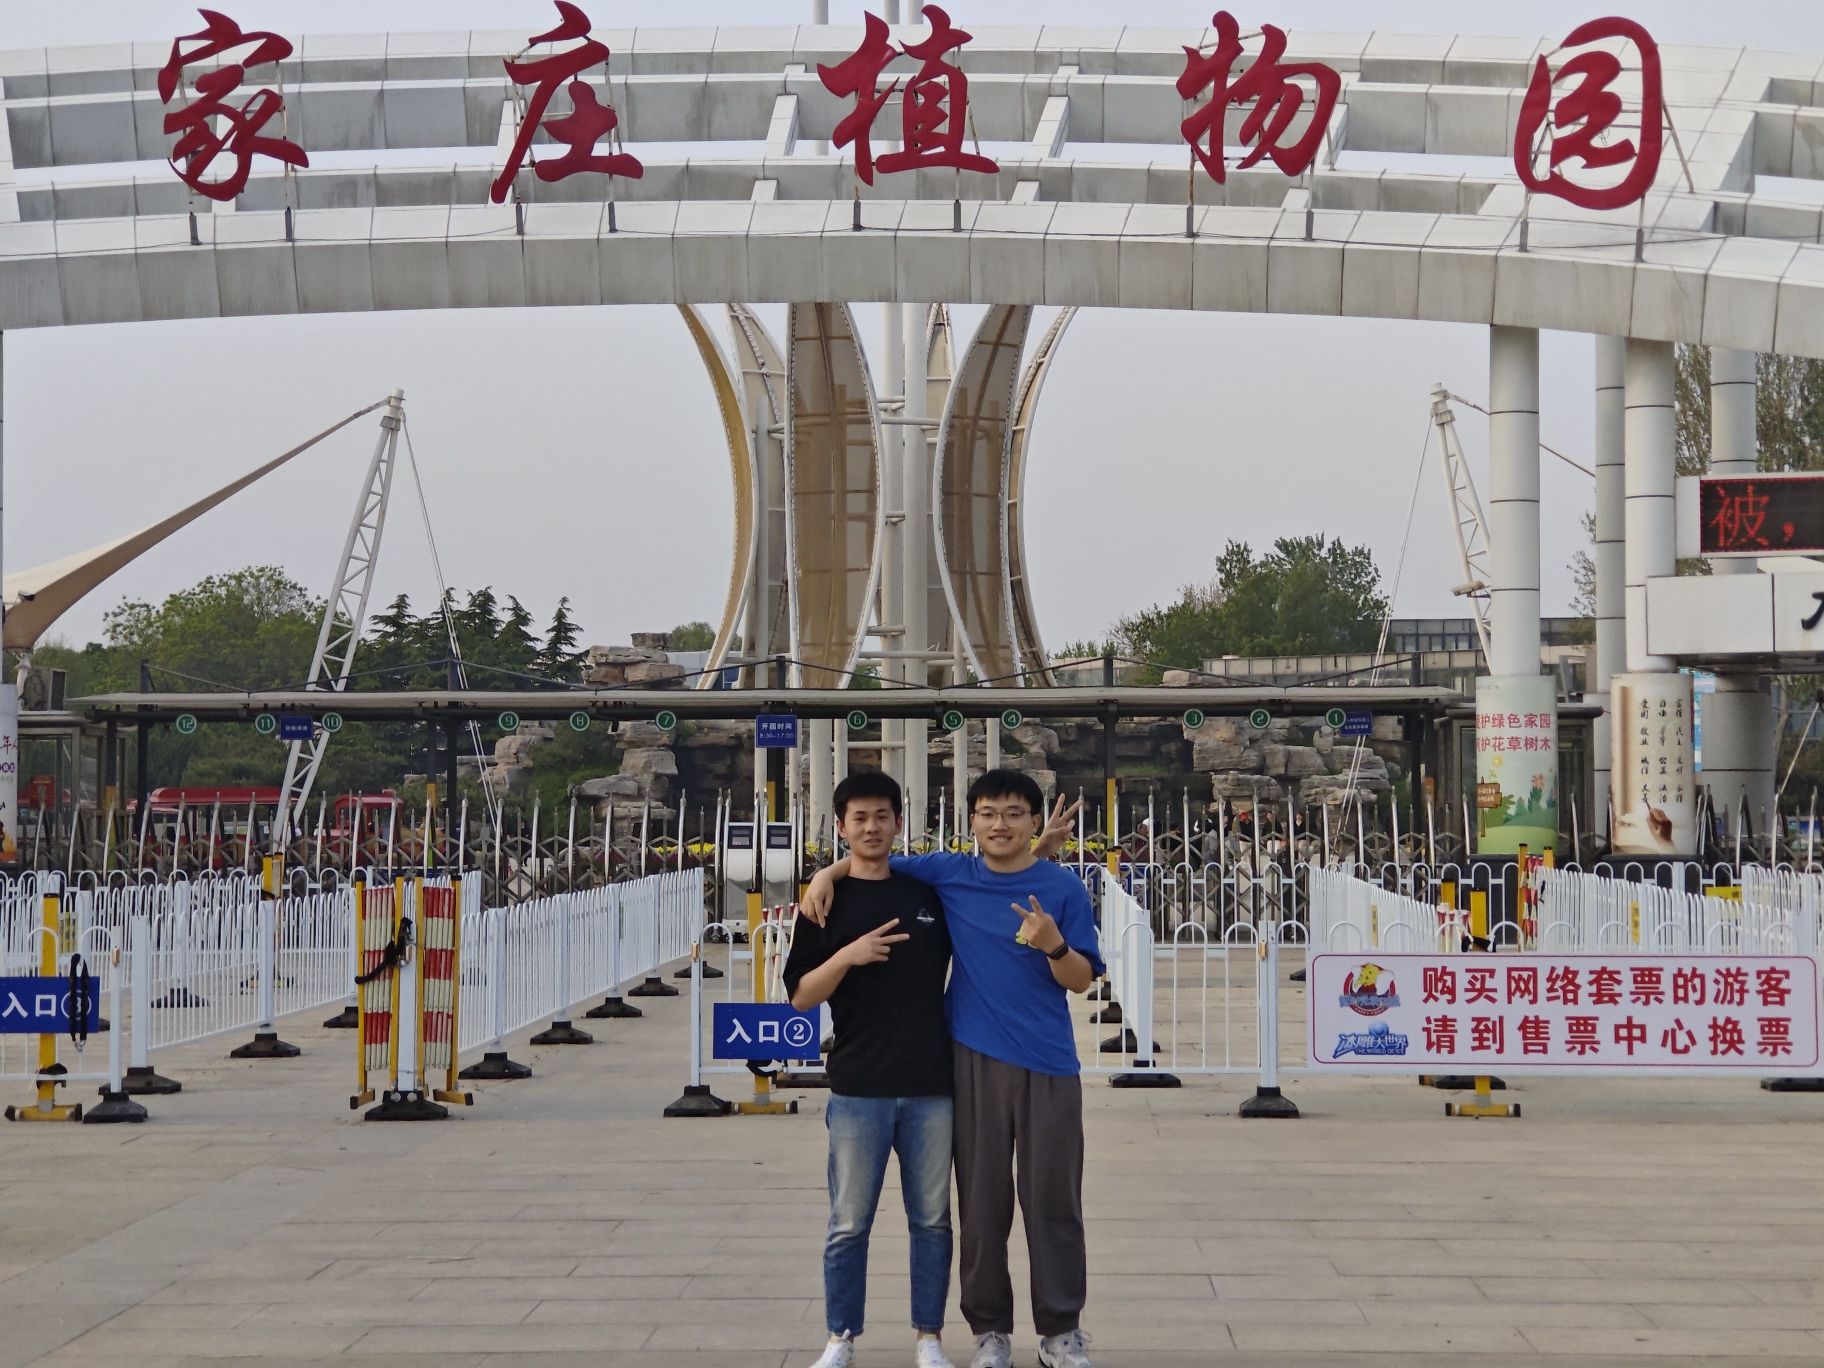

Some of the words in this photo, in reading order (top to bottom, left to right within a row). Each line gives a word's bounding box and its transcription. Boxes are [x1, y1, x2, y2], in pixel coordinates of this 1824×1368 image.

[1422, 965, 1792, 1007] 购买网络套票的游客
[1422, 1014, 1793, 1057] 请到售票中心换票
